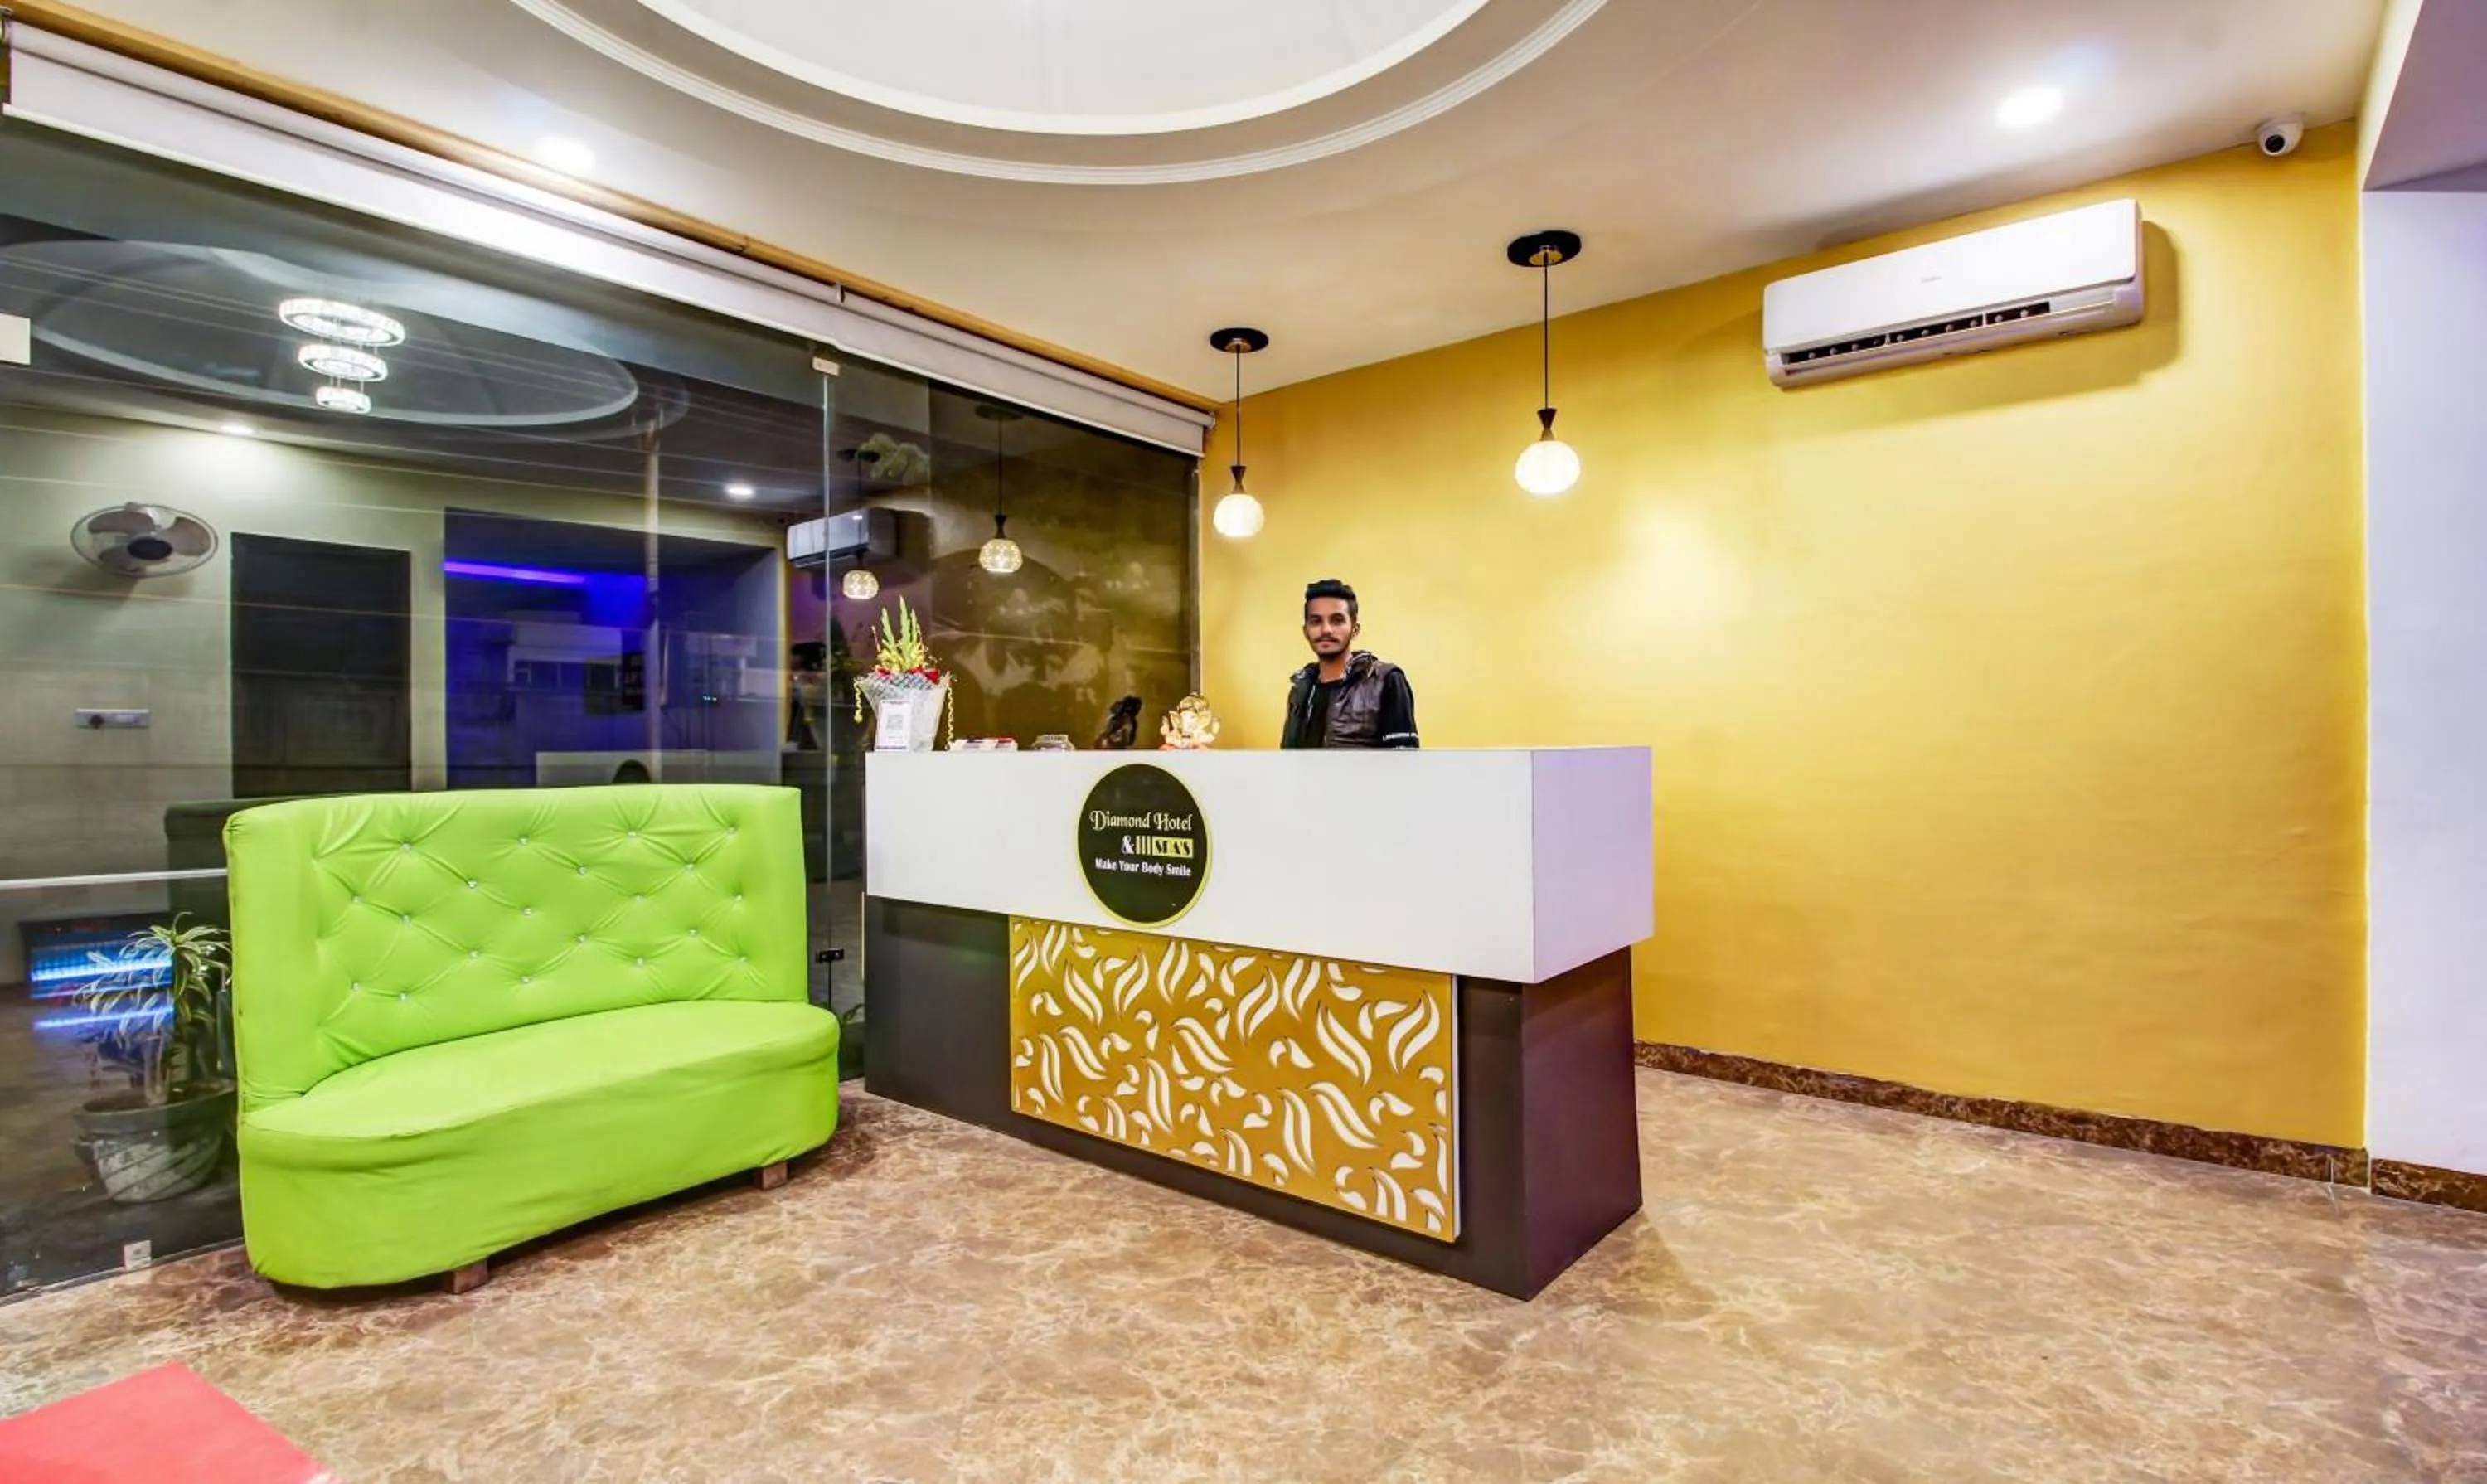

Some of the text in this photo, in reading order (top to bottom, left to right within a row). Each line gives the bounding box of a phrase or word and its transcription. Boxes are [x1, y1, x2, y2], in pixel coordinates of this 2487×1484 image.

[1089, 810, 1193, 832] Diamond Hotel
[1095, 857, 1192, 876] Make Your Body Smile
